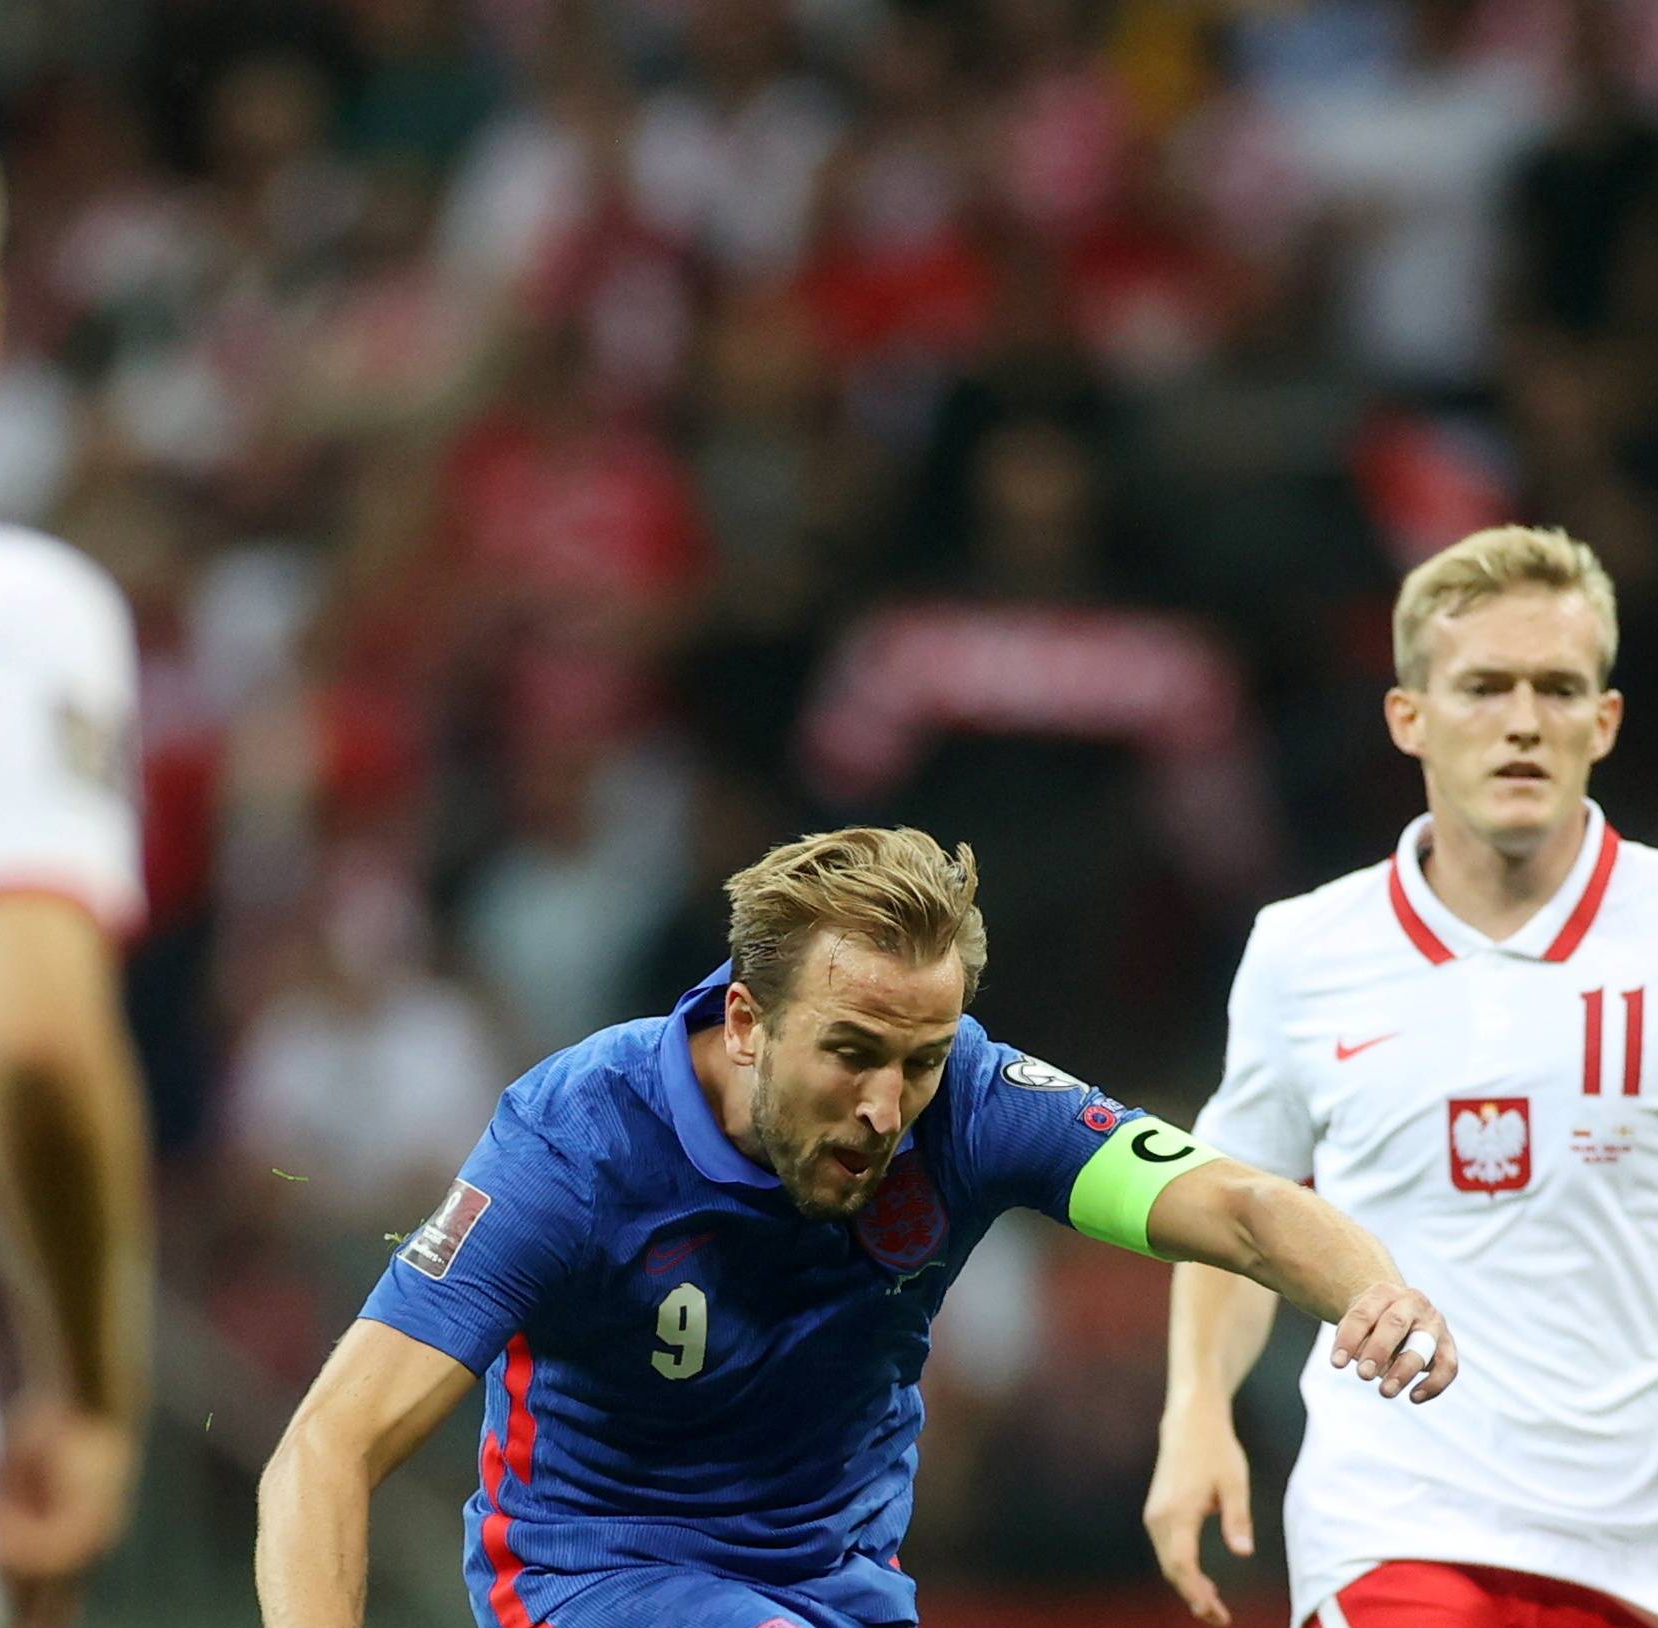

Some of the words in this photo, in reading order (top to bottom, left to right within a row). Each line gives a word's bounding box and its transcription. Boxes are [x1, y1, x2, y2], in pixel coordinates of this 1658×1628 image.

[1580, 985, 1645, 1096] 11
[1131, 1129, 1196, 1163] C
[650, 1282, 707, 1380] 9
